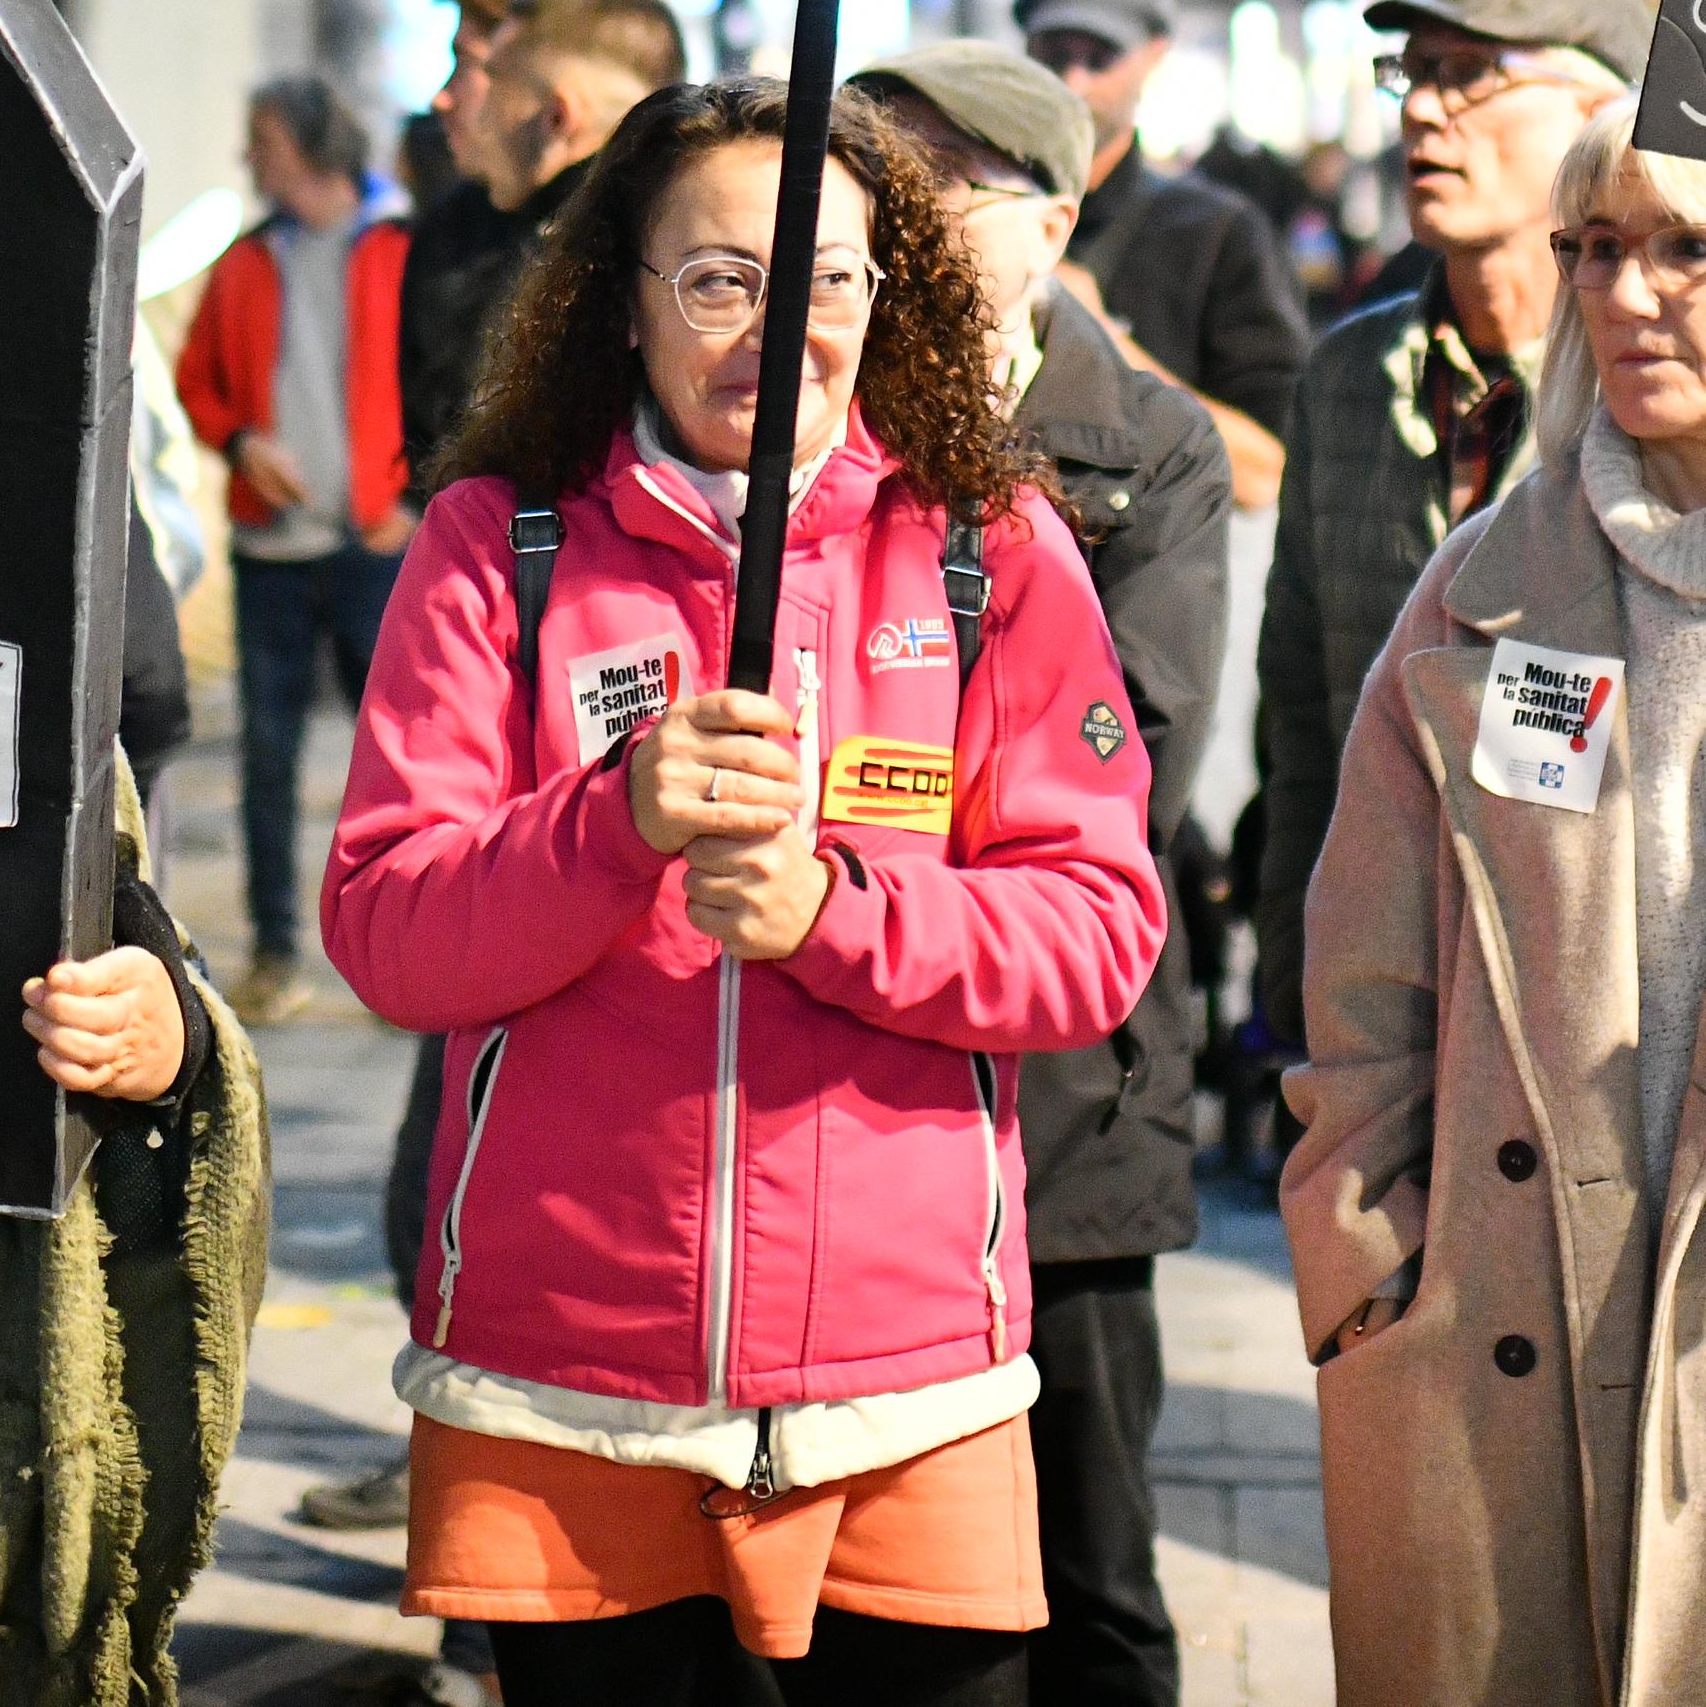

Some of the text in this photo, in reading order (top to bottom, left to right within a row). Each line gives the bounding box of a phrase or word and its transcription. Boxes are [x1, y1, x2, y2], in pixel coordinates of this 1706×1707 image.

[599, 658, 663, 691] Mou-te
[1523, 662, 1592, 694] Mou-te
[601, 678, 668, 714] sanitat
[1517, 686, 1588, 717] sanitat
[1084, 722, 1125, 739] NORWAY
[858, 761, 949, 798] CCOO
